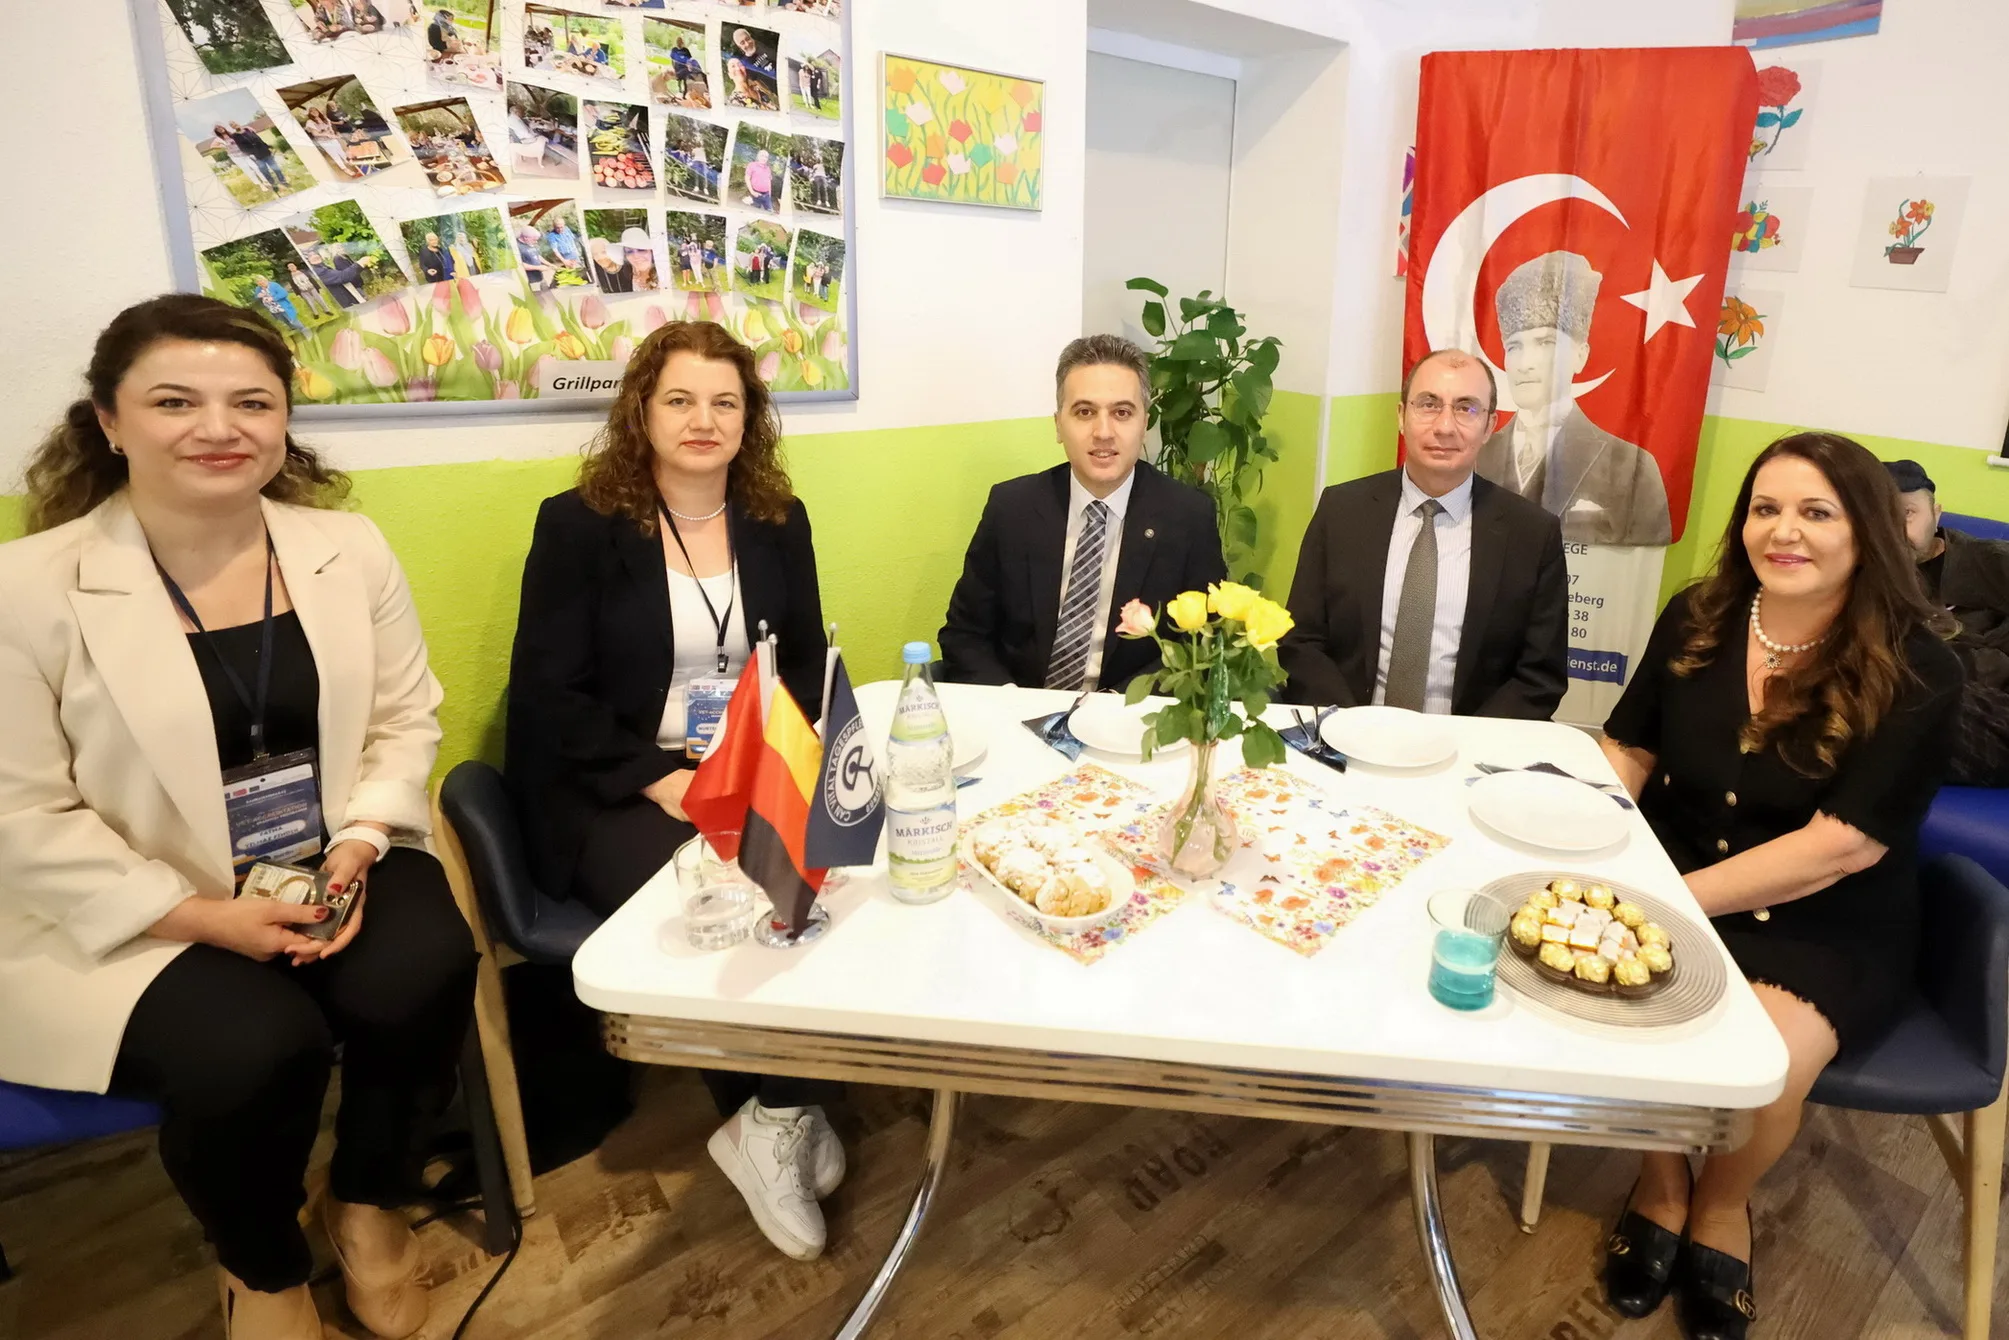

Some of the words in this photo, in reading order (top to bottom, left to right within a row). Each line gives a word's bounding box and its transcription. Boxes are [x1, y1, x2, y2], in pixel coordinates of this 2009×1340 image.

[1573, 610, 1589, 622] 38
[1571, 627, 1587, 639] 80
[834, 808, 852, 823] CAN
[895, 820, 953, 838] MÄRKISCH
